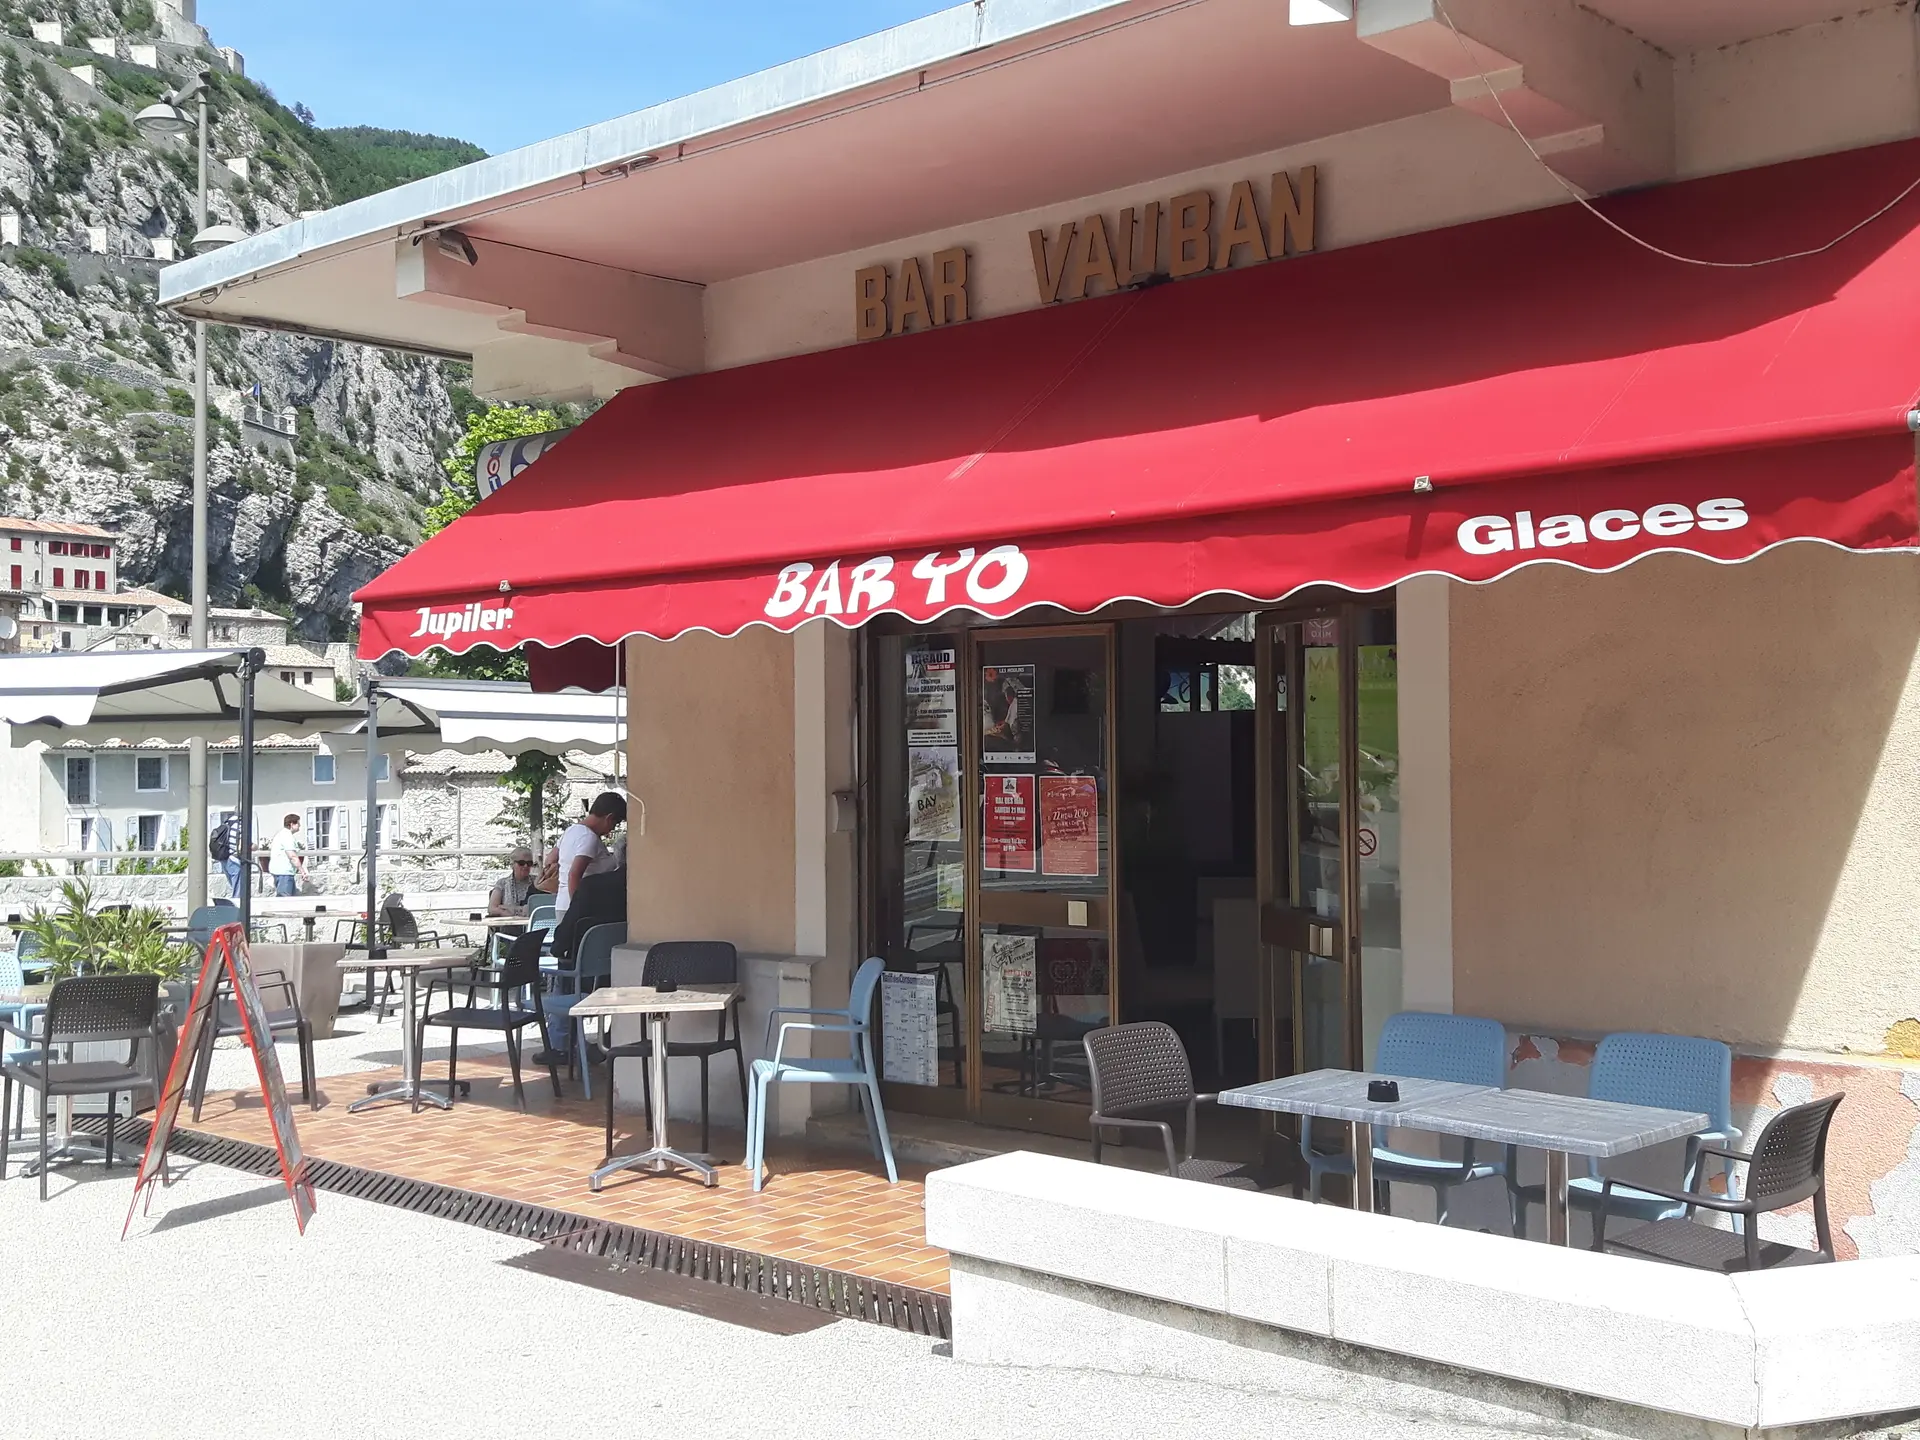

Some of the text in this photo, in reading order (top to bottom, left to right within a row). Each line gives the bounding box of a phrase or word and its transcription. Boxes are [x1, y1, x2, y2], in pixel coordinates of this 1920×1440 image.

[855, 165, 1318, 341] BAR VAUBAN
[1456, 497, 1749, 555] Glaces
[764, 545, 1029, 618] BAR YO
[917, 794, 937, 812] BAY
